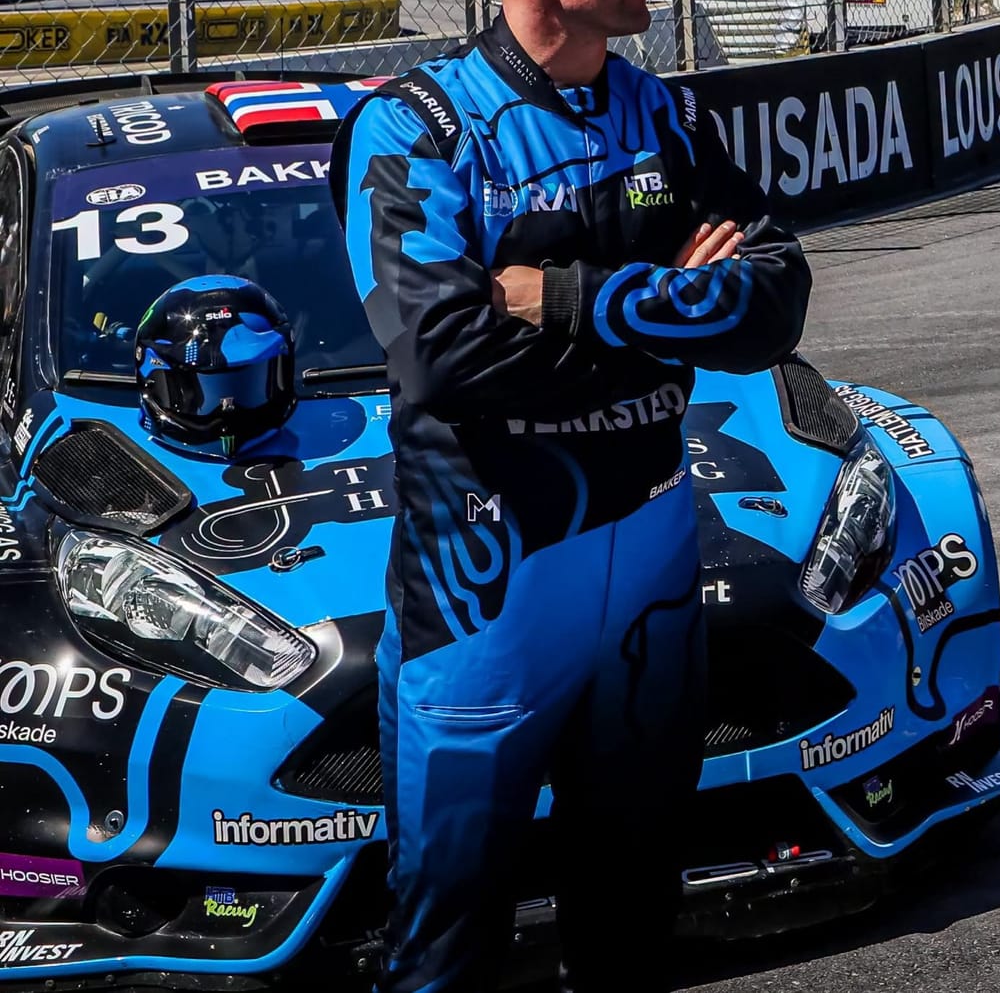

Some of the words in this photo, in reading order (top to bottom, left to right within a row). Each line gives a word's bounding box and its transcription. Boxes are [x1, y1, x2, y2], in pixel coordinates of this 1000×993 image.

[709, 80, 914, 196] USADA
[51, 203, 190, 262] 13
[205, 308, 232, 321] Stilo
[916, 602, 954, 632] Bilskade
[800, 706, 896, 771] informativ
[213, 810, 378, 845] informativ
[1, 868, 80, 887] HOOSIER
[204, 899, 258, 927] Racing
